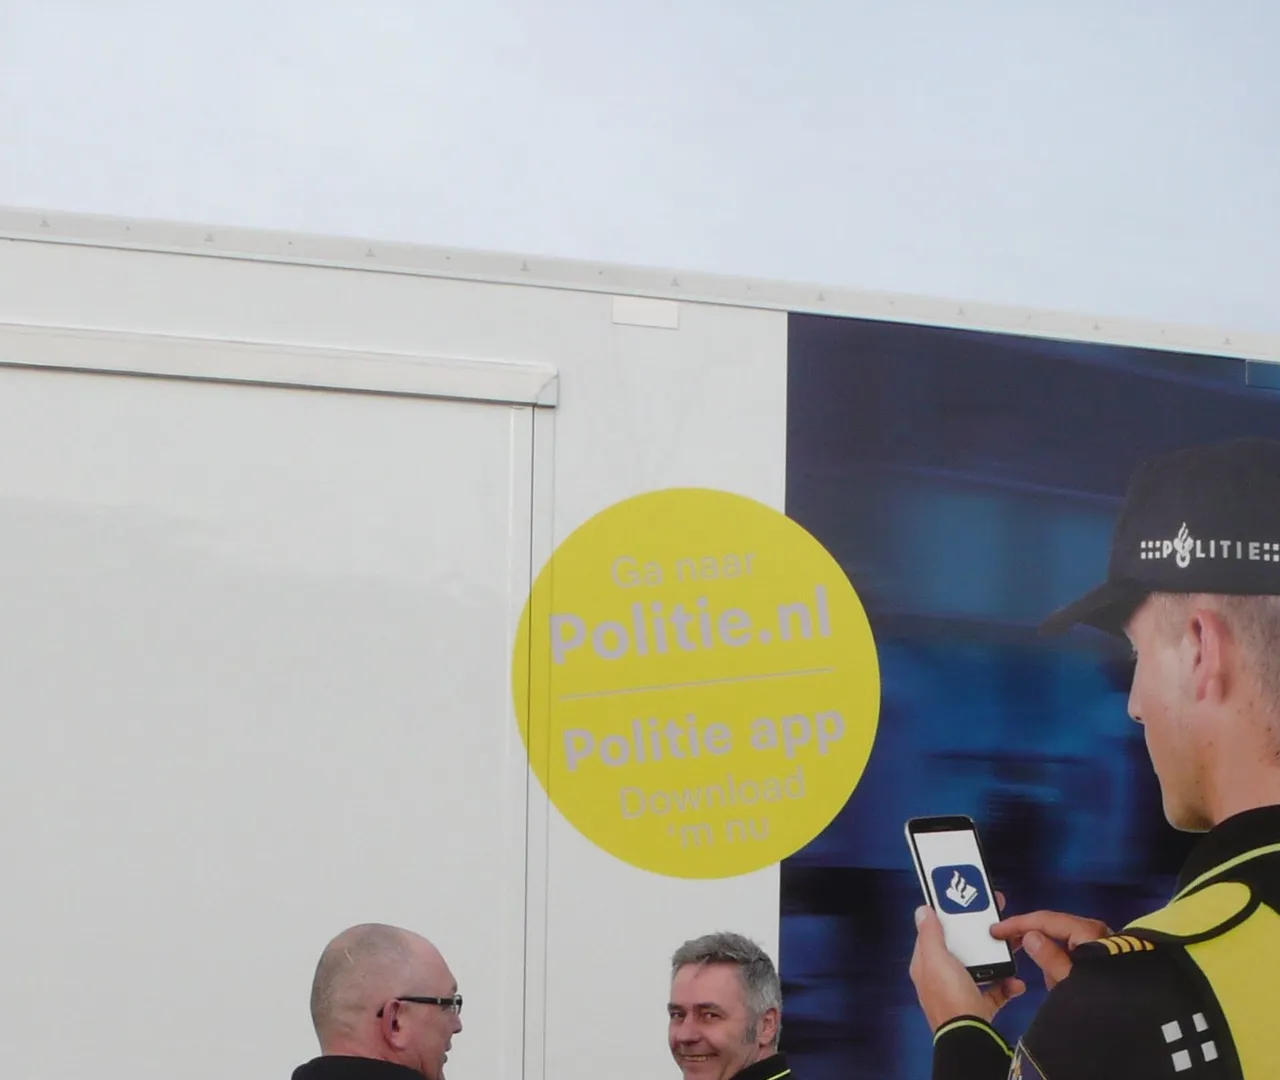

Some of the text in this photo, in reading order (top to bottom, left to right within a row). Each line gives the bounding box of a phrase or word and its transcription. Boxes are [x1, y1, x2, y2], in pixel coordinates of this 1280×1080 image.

[610, 551, 756, 588] Ga naar
[1162, 539, 1260, 568] POLITIE
[549, 584, 832, 665] Politie.nl
[562, 709, 846, 772] Politie app
[620, 765, 806, 819] Download
[725, 817, 770, 844] nu
